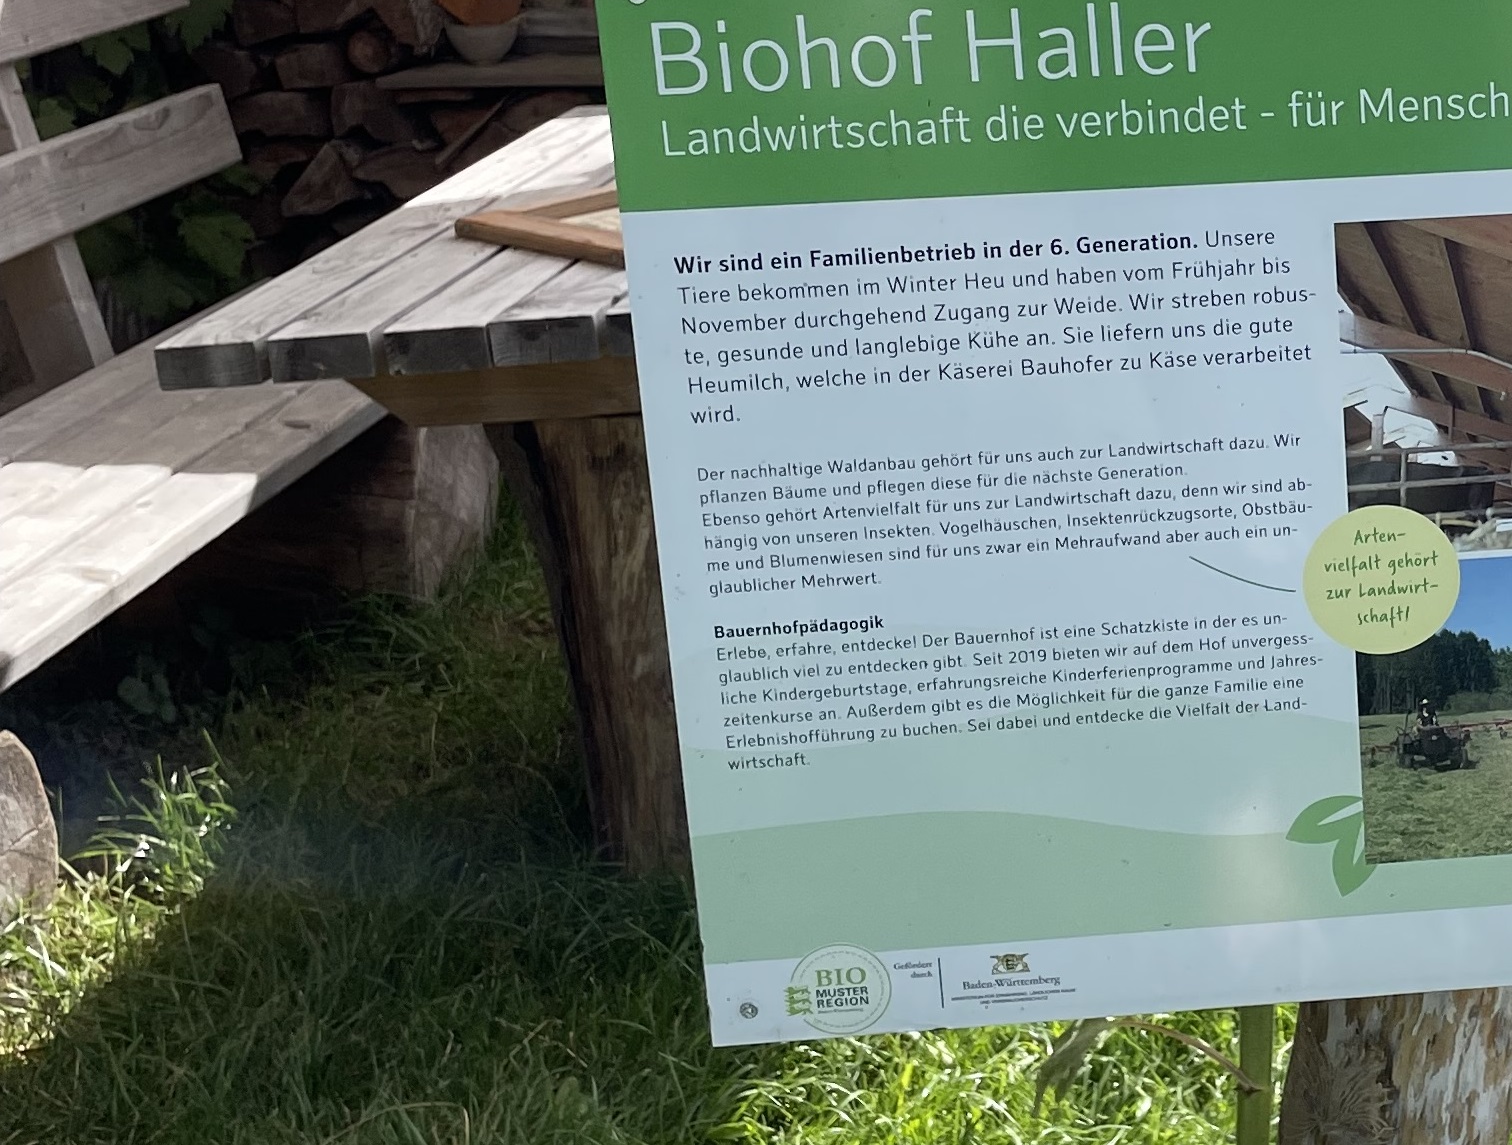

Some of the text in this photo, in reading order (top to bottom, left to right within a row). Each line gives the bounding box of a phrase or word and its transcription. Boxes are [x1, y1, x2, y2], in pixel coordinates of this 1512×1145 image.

[649, 1, 1211, 95] Biohof Haller
[661, 105, 971, 156] Landwirtschaft
[985, 103, 1044, 142] die
[1055, 94, 1247, 138] verbindet
[1287, 89, 1344, 127] für
[672, 229, 1275, 274] Wir sind ein Familienbetrieb in der 6. Generation. Unsere
[676, 255, 1291, 304] Tiere bekommen im Winter Heu und haben vom Frühjahr bis
[680, 284, 1316, 335] November durchgehend Zugang zur Weide. Wir streben robus-
[683, 316, 1293, 368] te, gesunde und langlebige Kühe an. Sie liefern uns die gute
[687, 343, 1312, 394] Heumilch, welche in der Käserei Bauhofer zu Käse verarbeitet
[689, 403, 740, 424] wird.
[696, 466, 725, 482] Der
[729, 460, 822, 480] nachhaltige
[826, 455, 916, 474] Waldanbau
[920, 452, 973, 472] gehört
[977, 449, 1000, 466] für
[1004, 451, 1033, 464] uns
[1036, 445, 1074, 462] auch
[1078, 447, 1103, 460] zur
[1107, 436, 1224, 458] Landwirtschaft
[1272, 432, 1301, 448] Wir
[1352, 526, 1406, 546] Arten-
[1323, 549, 1439, 578] vielfalt gehört
[1325, 576, 1439, 600] zur Landwirt-
[712, 614, 885, 639] Bauernhofpädagogik
[715, 644, 771, 661] Erlebe,
[775, 640, 836, 657] erfahre,
[921, 633, 950, 648] Der
[953, 625, 1035, 646] Bauernhof
[1039, 625, 1059, 640] ist
[1062, 623, 1096, 639] eine
[1100, 617, 1189, 636] Schatzkiste
[1193, 616, 1207, 630] in
[1211, 613, 1237, 629] der
[1240, 615, 1259, 627] es
[1262, 613, 1287, 625] un-
[814, 966, 868, 988] BIO
[815, 985, 869, 999] MUSTER
[962, 975, 1061, 991] Baden-Württemberg
[816, 995, 870, 1009] REGION
